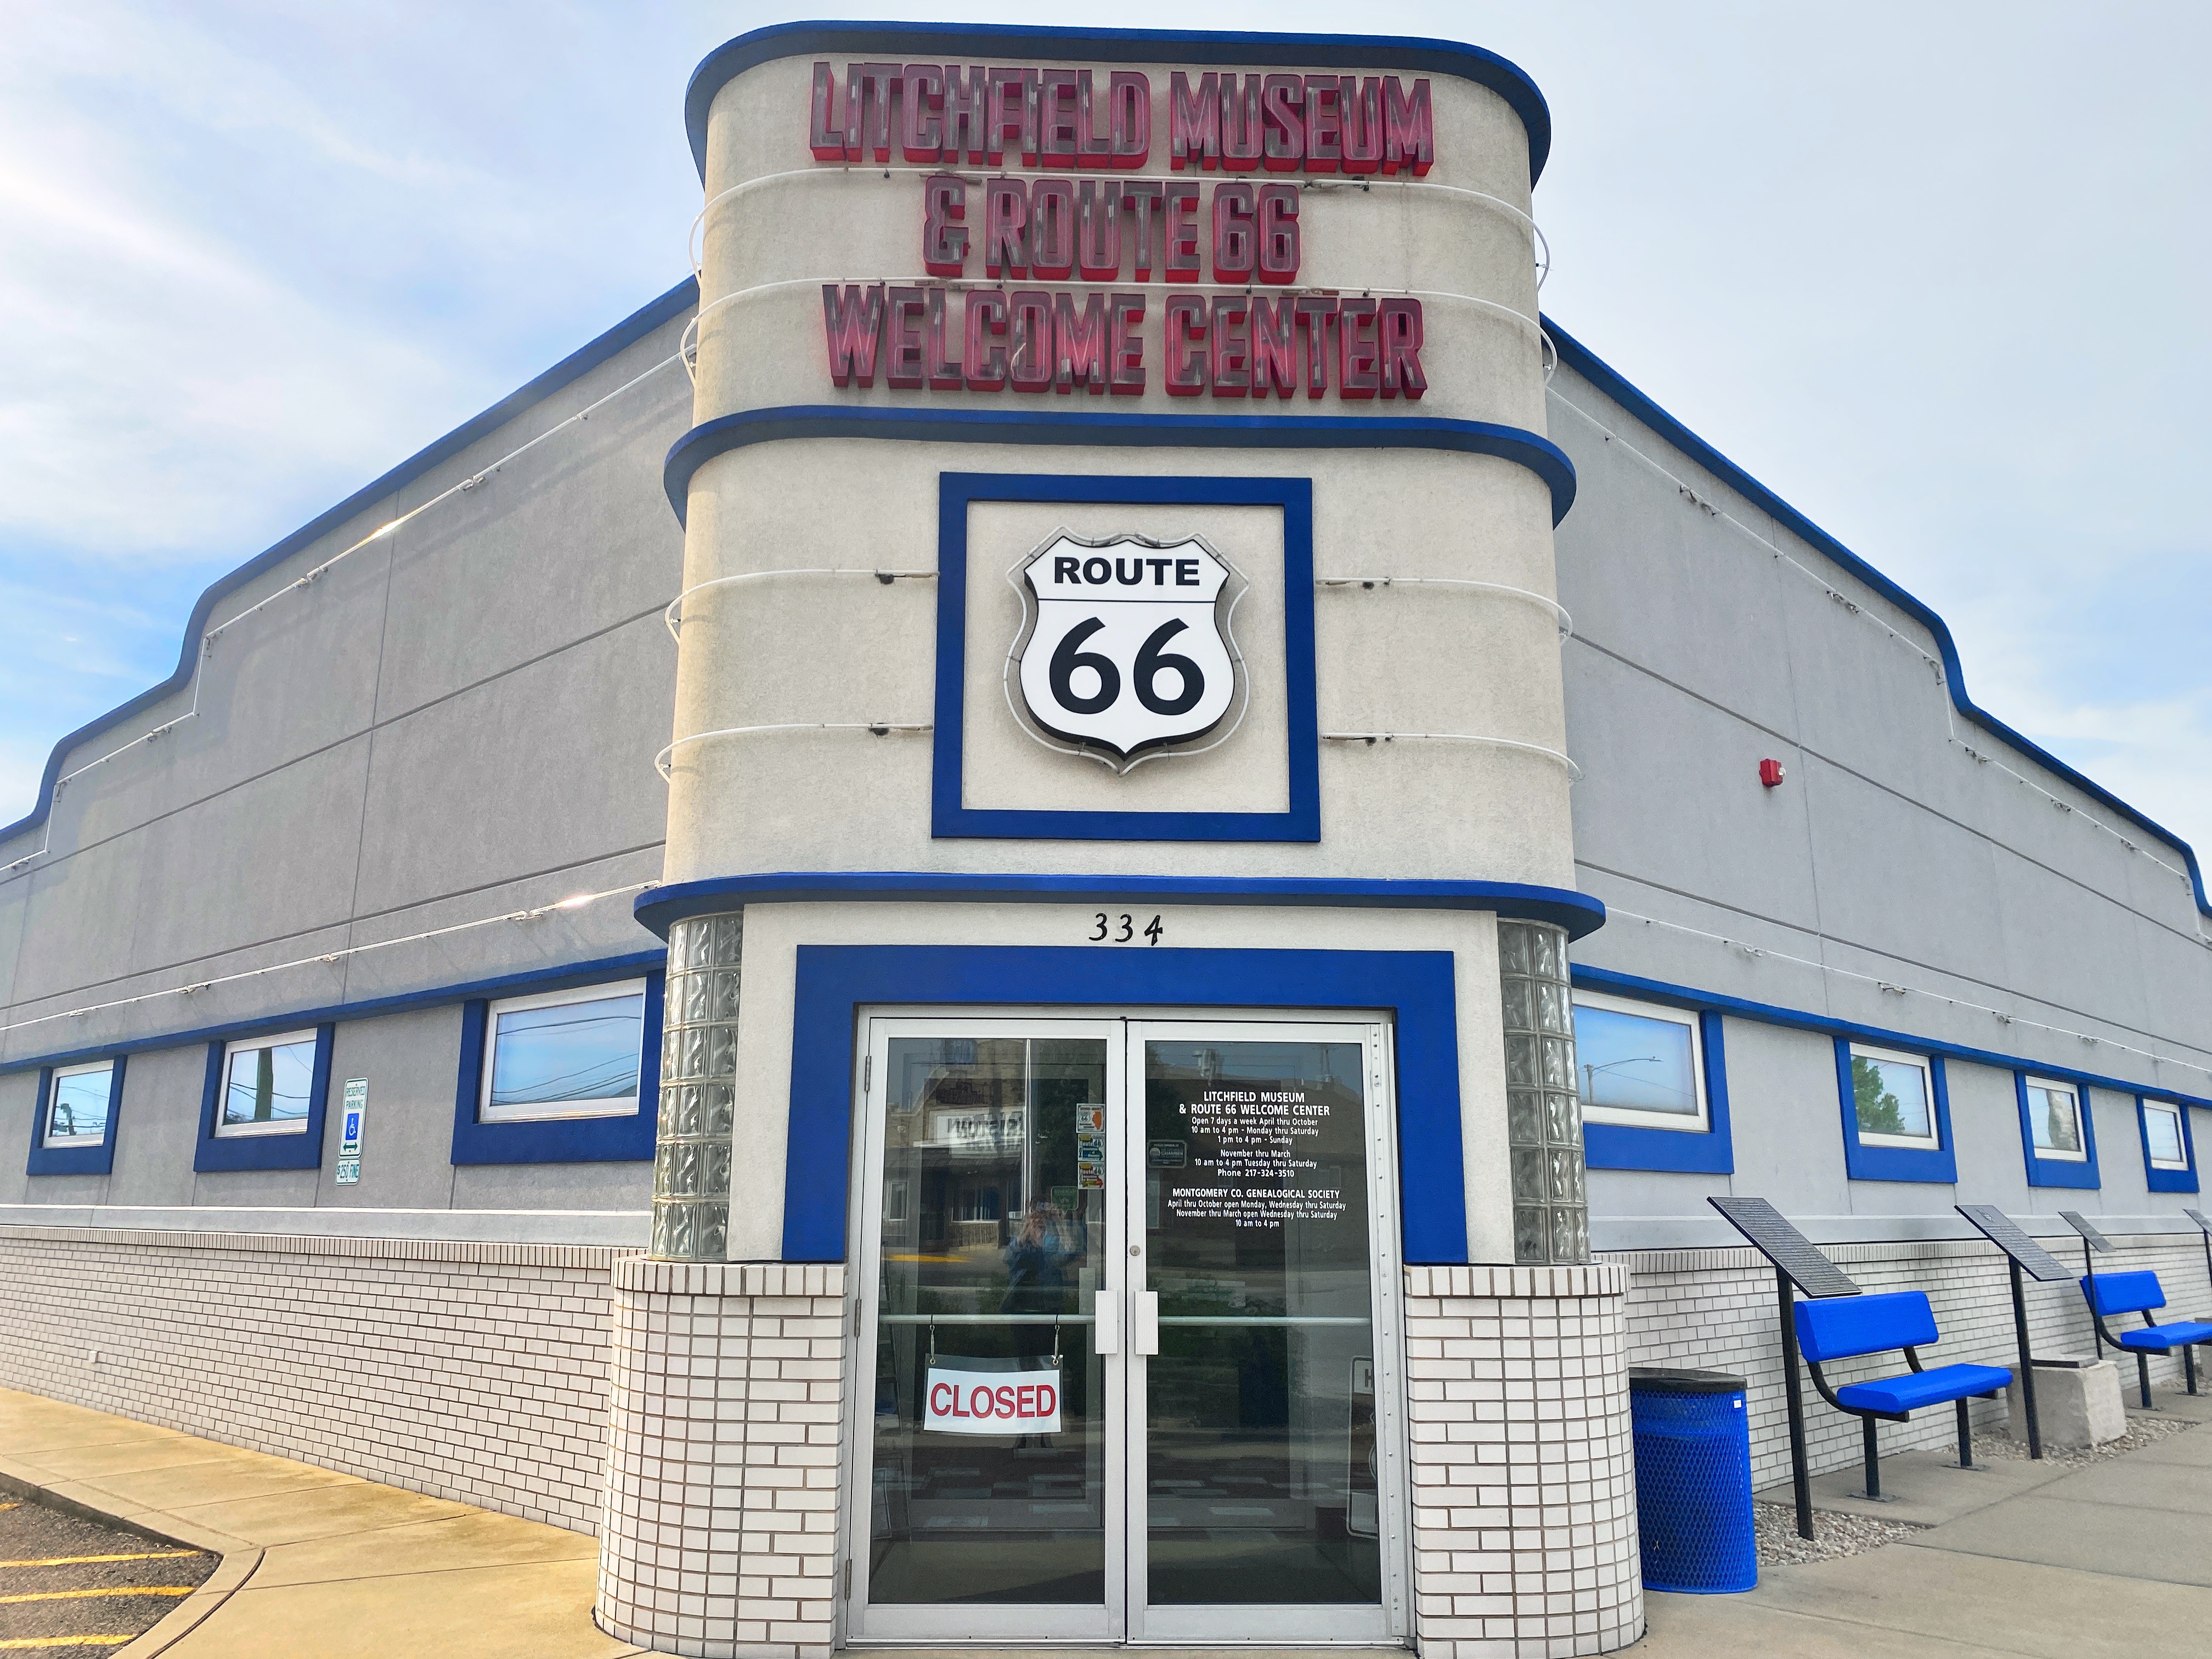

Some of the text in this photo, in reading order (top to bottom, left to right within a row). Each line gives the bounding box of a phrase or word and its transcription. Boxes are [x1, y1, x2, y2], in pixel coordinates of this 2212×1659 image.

[810, 61, 1435, 176] LITCHFIELD MUSEUM
[924, 174, 1300, 284] & ROUTE 66
[822, 284, 1428, 400] WELCOME CENTER
[1054, 556, 1200, 586] ROUTE
[1049, 617, 1205, 716] 66
[1089, 913, 1163, 946] 334
[346, 1086, 365, 1097] RESERVED
[1204, 1091, 1305, 1103] LITCHFIELD MUSEUM
[346, 1099, 363, 1110] PARKING
[1179, 1103, 1330, 1116] & ROUTE 66 WELCOME CENTER
[1192, 1116, 1209, 1125] Open
[1210, 1116, 1215, 1125] 7
[1216, 1116, 1232, 1126] days
[1239, 1116, 1257, 1125] week
[1259, 1116, 1275, 1127] April
[1276, 1117, 1290, 1126] thru
[1292, 1118, 1318, 1126] October
[1222, 1126, 1226, 1134] 4
[1228, 1127, 1239, 1136] pm
[1246, 1126, 1273, 1136] Monday
[1274, 1126, 1288, 1135] thru
[1290, 1126, 1319, 1137] Saturday
[1223, 1137, 1234, 1145] pm
[1251, 1137, 1262, 1146] pm
[1269, 1136, 1293, 1146] Sunday
[1220, 1149, 1291, 1158] November thru March
[1194, 1158, 1201, 1166] 10
[1232, 1160, 1243, 1169] pm
[1244, 1159, 1271, 1169] Tuesday
[1272, 1159, 1286, 1167] thru
[1288, 1159, 1317, 1170] Saturday
[349, 1164, 359, 1178] FINE
[1217, 1169, 1295, 1177] Phone 217-324-3510
[1172, 1188, 1340, 1199] MONTGOMERY CO. GENEALOGICAL SOCIETY
[1167, 1199, 1346, 1211] April thru October open Monday, Wednesday thru Saturday
[1176, 1209, 1207, 1217] November
[1223, 1210, 1242, 1218] March
[1243, 1211, 1259, 1220] open
[1260, 1210, 1295, 1220] Wednesday
[1296, 1210, 1309, 1218] thru
[1311, 1210, 1338, 1220] Saturday
[1235, 1219, 1242, 1227] 10
[1263, 1219, 1268, 1227] 4
[1269, 1221, 1279, 1229] pm
[930, 1383, 1057, 1419] CLOSED
